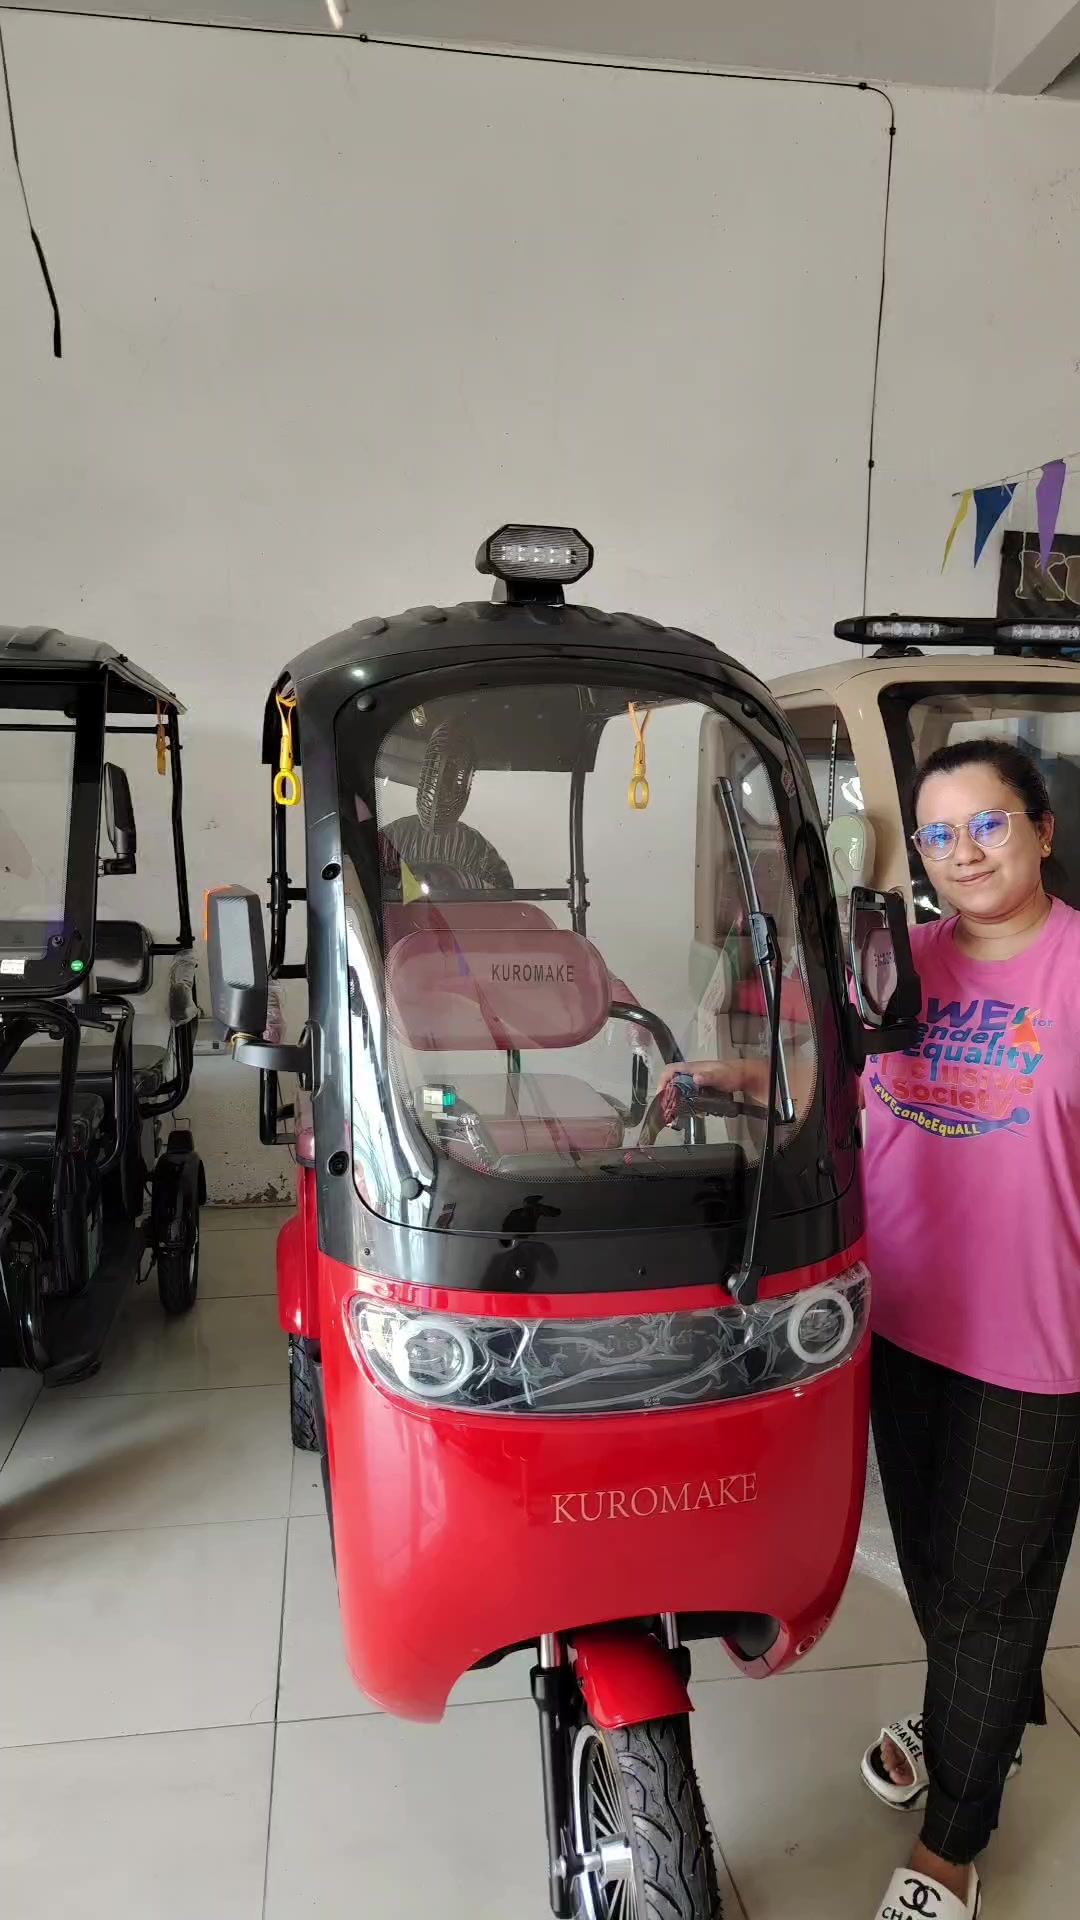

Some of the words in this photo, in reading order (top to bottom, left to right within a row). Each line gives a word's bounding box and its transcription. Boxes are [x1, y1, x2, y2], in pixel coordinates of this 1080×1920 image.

[491, 962, 575, 982] KUROMAKE
[927, 997, 1015, 1031] WE
[1033, 1017, 1054, 1027] for
[912, 1023, 1005, 1049] ender
[873, 1083, 981, 1137] #WEcanbeEquALL
[551, 1472, 758, 1524] KUROMAKE
[889, 1722, 923, 1762] CHANEL
